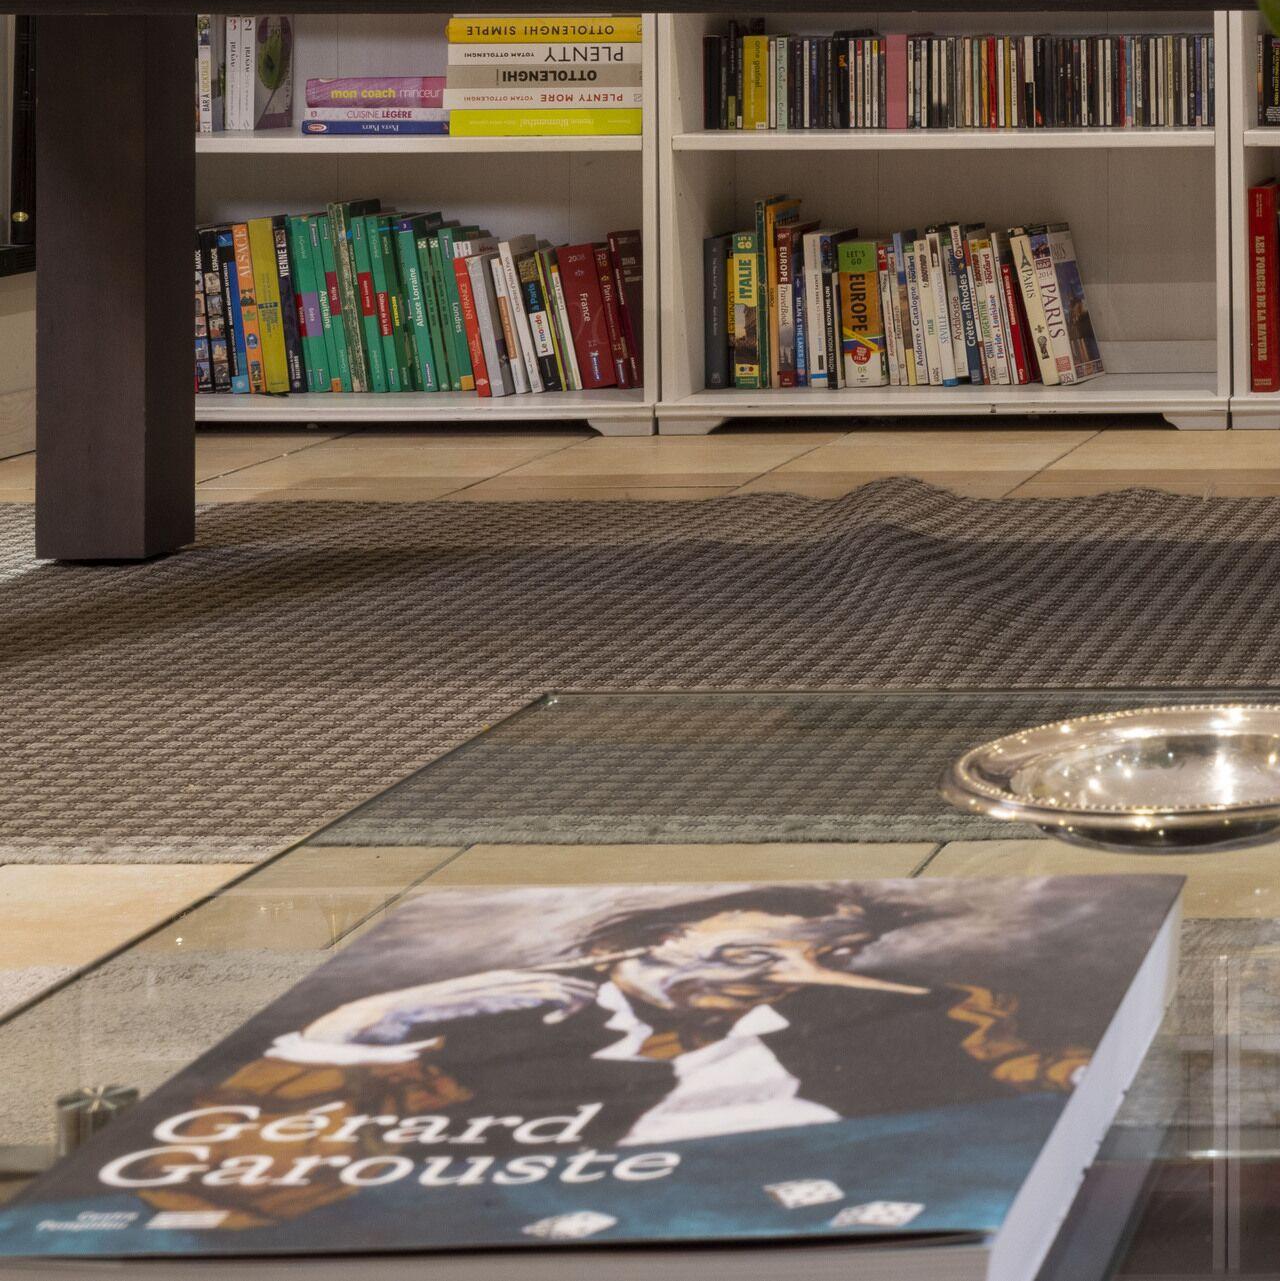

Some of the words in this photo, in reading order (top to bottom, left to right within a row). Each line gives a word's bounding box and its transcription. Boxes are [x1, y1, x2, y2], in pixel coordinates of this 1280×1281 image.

[466, 25, 517, 36] SIMPLE
[523, 25, 615, 36] OTTOLENGHI
[543, 46, 624, 63] PLENTY
[199, 60, 210, 93] COCKTAILS
[501, 70, 598, 82] OTTOLENGHI
[199, 99, 210, 112] BAR
[331, 89, 358, 99] mon
[361, 88, 397, 99] coach
[399, 87, 441, 99] minceur
[539, 93, 574, 102] MORE
[579, 93, 624, 102] PLENTY
[347, 110, 379, 119] CUISINE
[234, 228, 251, 280] ALSACE
[846, 250, 866, 258] LET'S
[1255, 235, 1267, 254] LES
[194, 249, 203, 270] MAROC
[210, 247, 219, 271] ESPAGNE
[277, 249, 289, 277] VIENNE
[780, 246, 788, 283] EUROPE
[408, 267, 420, 300] Lorraine
[738, 259, 752, 299] ITALIE
[1255, 257, 1267, 293] FORCES
[460, 282, 472, 309] FRANCE
[526, 282, 539, 306] Paris
[601, 283, 612, 302] Paris
[779, 285, 789, 327] TravelBook
[849, 272, 869, 332] EUROPE
[910, 286, 920, 326] Catalogne
[958, 274, 971, 311] Rhodes
[1022, 277, 1035, 308] PARIS
[1255, 294, 1267, 308] DE
[319, 289, 331, 329] Aquitaine
[413, 301, 424, 328] Alsace
[451, 302, 463, 333] Londres
[578, 292, 592, 322] France
[953, 296, 963, 341] Andalousie
[980, 299, 991, 339] ARGENTINE
[989, 294, 1000, 329] Louisiane
[1040, 283, 1066, 339] PARIS
[1255, 309, 1267, 321] LA
[534, 314, 548, 342] monde
[965, 320, 976, 347] Crète
[1255, 323, 1268, 361] NATURE
[797, 336, 805, 357] LAKES
[914, 333, 923, 367] Andorre
[985, 341, 995, 359] CHILI
[994, 333, 1005, 359] Floride
[152, 1101, 604, 1144] Gérard
[98, 1145, 682, 1188] Garouste
